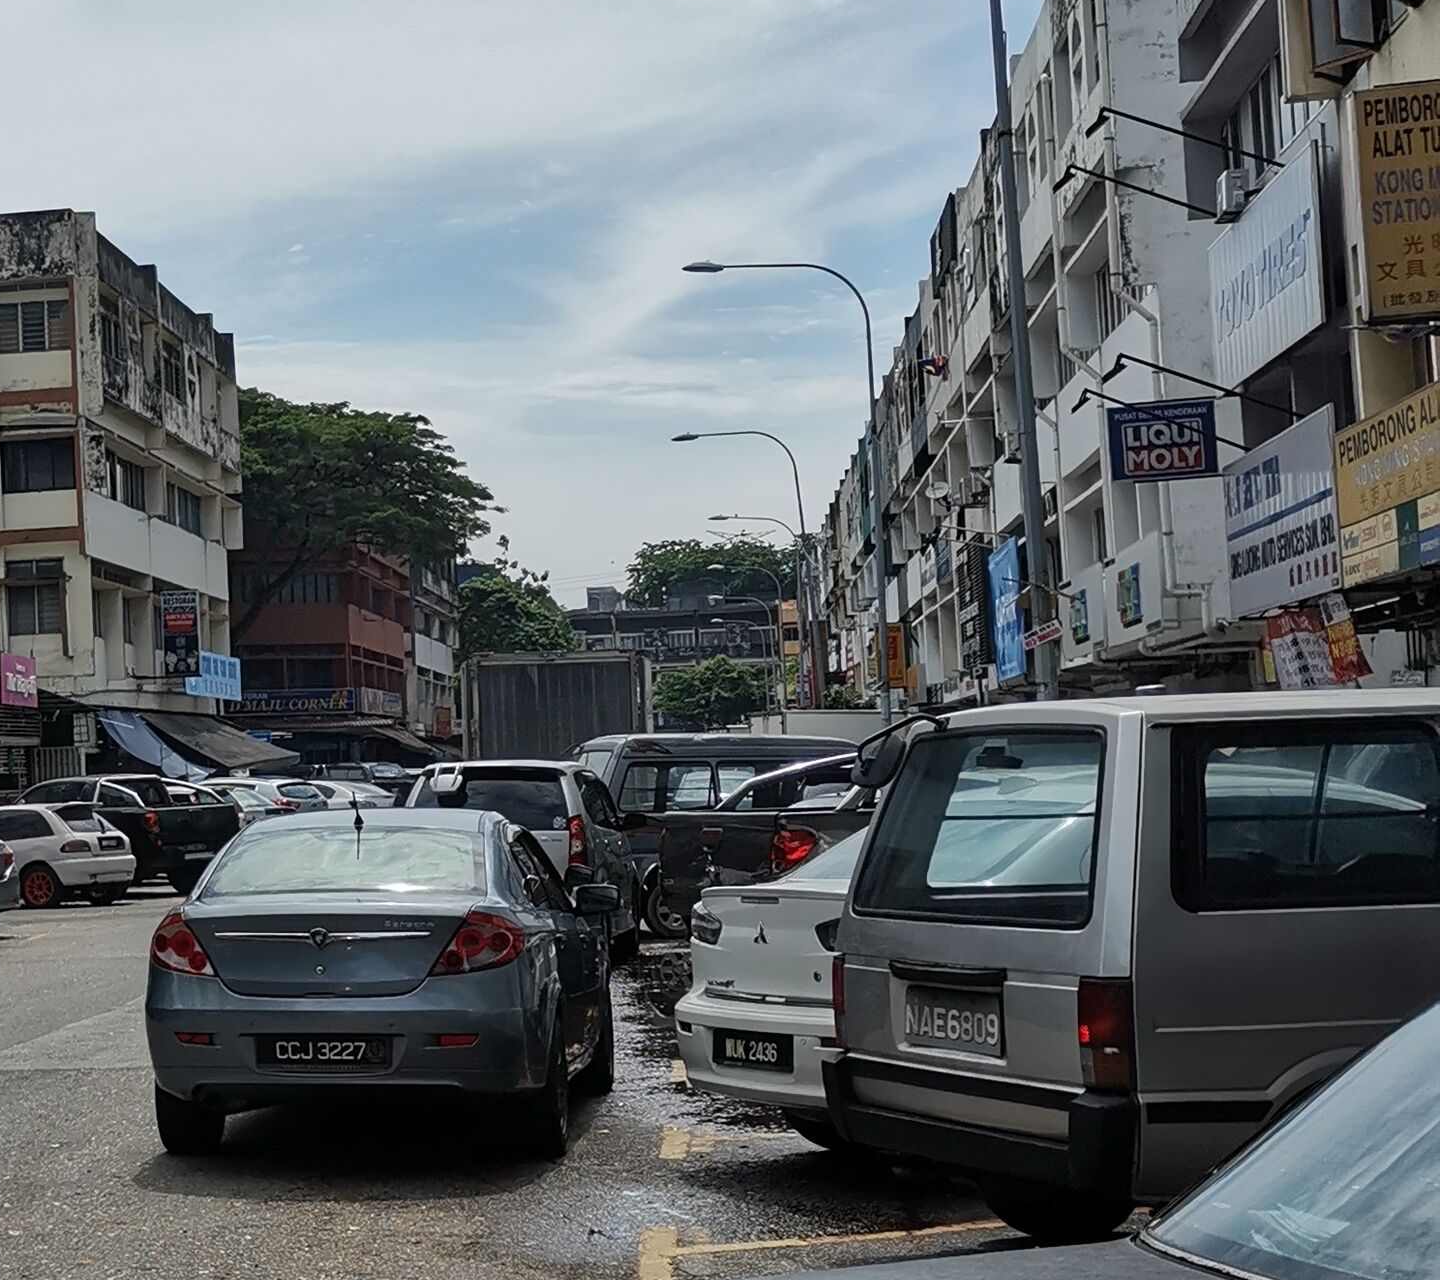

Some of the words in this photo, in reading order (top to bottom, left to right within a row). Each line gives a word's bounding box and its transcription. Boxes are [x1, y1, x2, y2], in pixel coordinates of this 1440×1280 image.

[1372, 127, 1413, 159] ALAT
[1374, 168, 1424, 195] KONG
[1126, 421, 1200, 448] LIQUI
[1338, 403, 1417, 467] PEMBORONG
[1420, 397, 1440, 426] AL
[1127, 445, 1200, 472] MOLY
[288, 697, 349, 710] CORNER
[275, 1041, 313, 1059] CCJ
[317, 1042, 366, 1059] 3227
[748, 1041, 778, 1062] 2436
